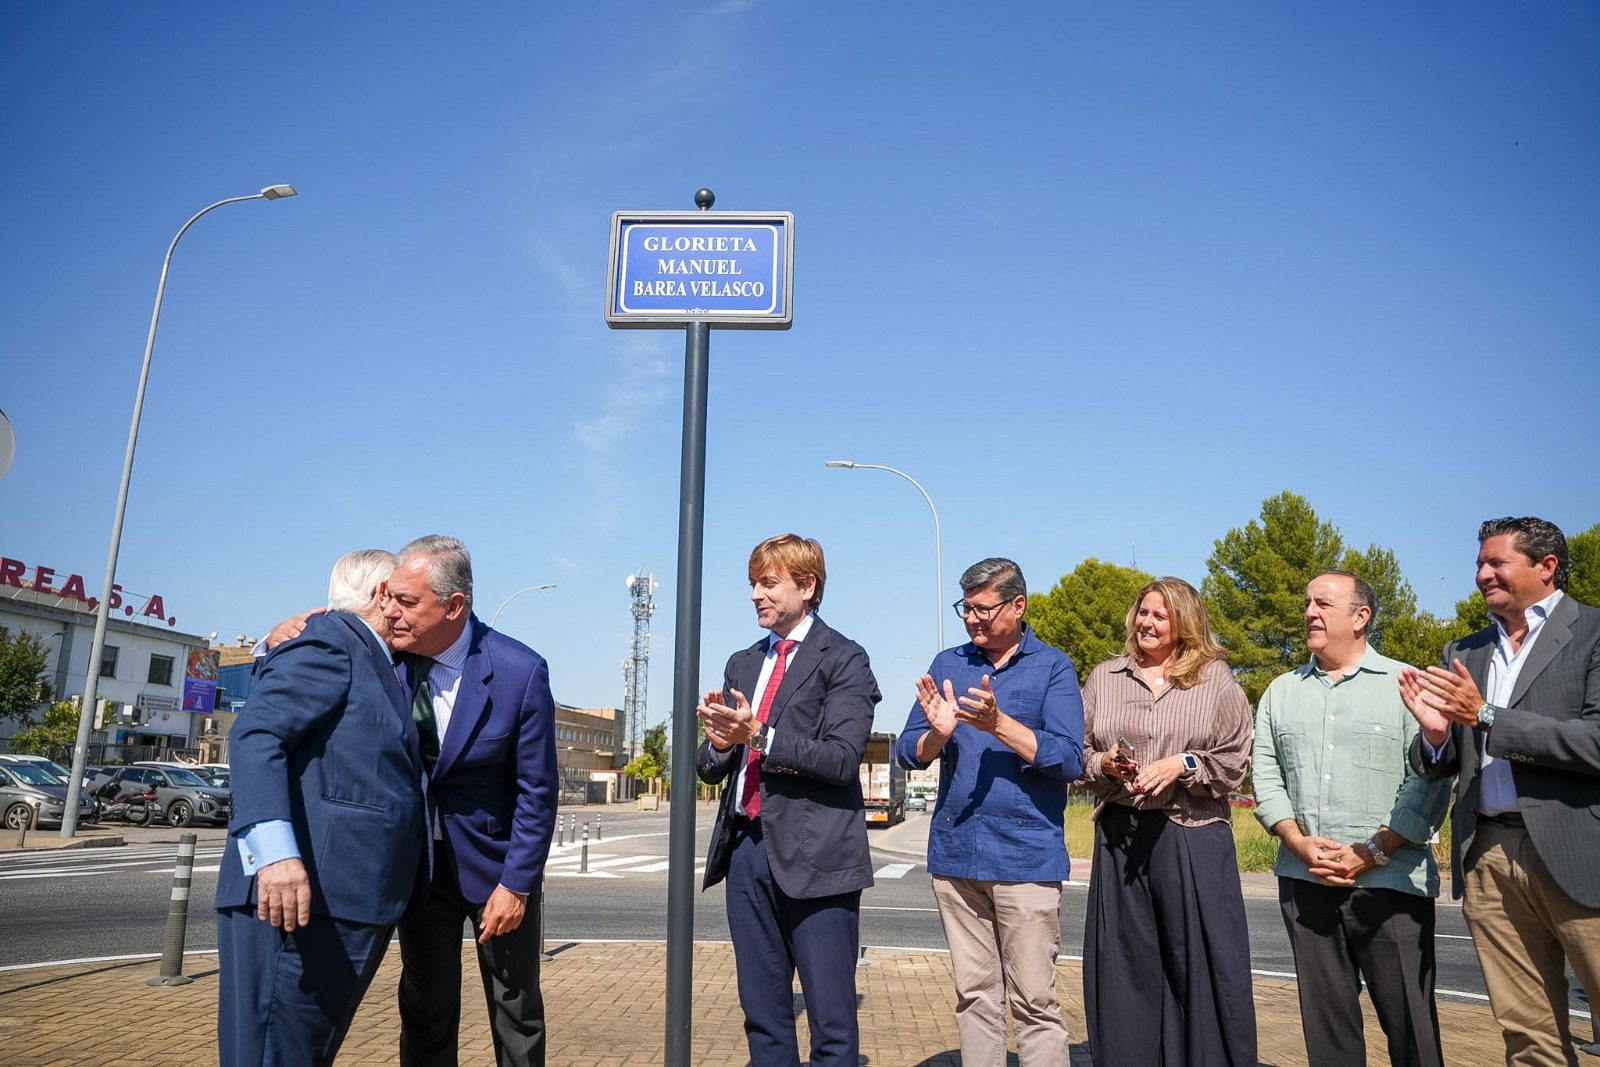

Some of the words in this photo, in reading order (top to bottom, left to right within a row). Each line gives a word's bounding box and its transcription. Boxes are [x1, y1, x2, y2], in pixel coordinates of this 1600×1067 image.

[643, 236, 757, 252] GLORIETA
[657, 259, 742, 275] MANUEL
[633, 280, 687, 296] BAREA
[690, 280, 765, 297] VELASCO
